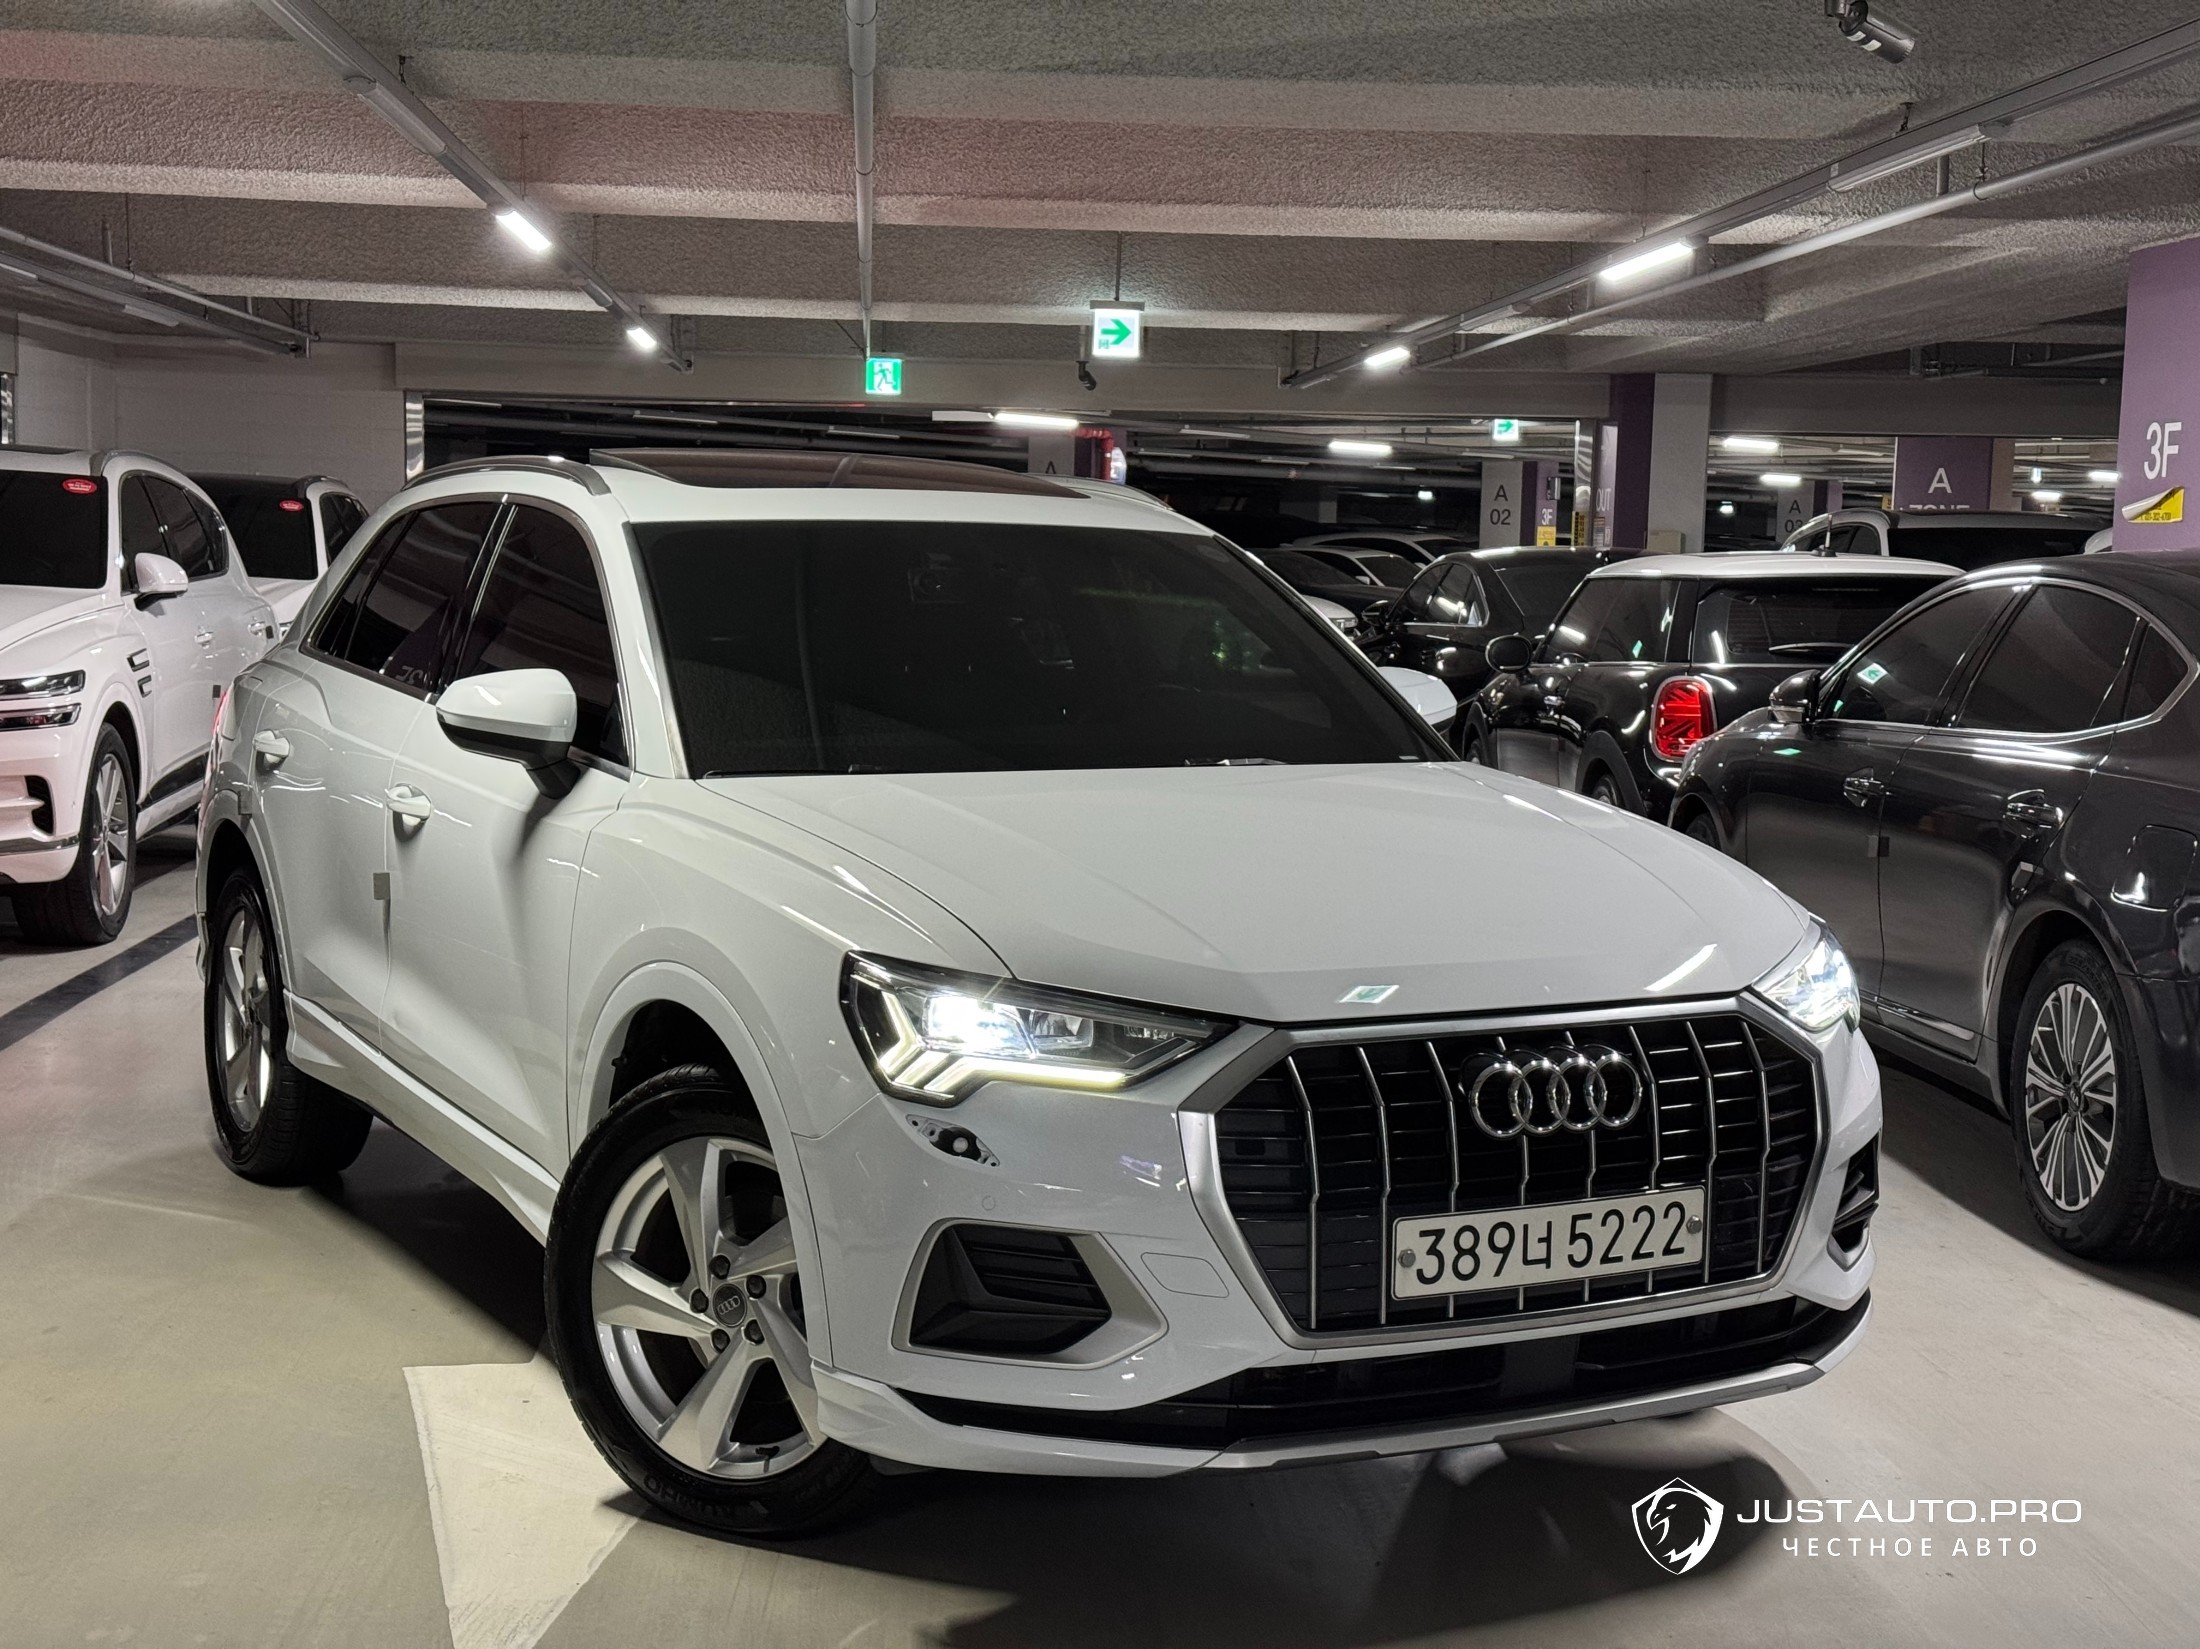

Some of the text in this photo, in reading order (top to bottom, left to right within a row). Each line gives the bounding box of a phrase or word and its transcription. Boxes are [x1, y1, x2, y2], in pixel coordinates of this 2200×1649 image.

[2143, 421, 2182, 480] 3F
[1927, 467, 1953, 494] A
[1494, 484, 1508, 501] A
[1595, 487, 1612, 512] OUT
[1490, 508, 1511, 525] 02
[1541, 508, 1553, 525] 3F
[1788, 499, 1801, 514] A
[1415, 1200, 1686, 1285] 389너 5222
